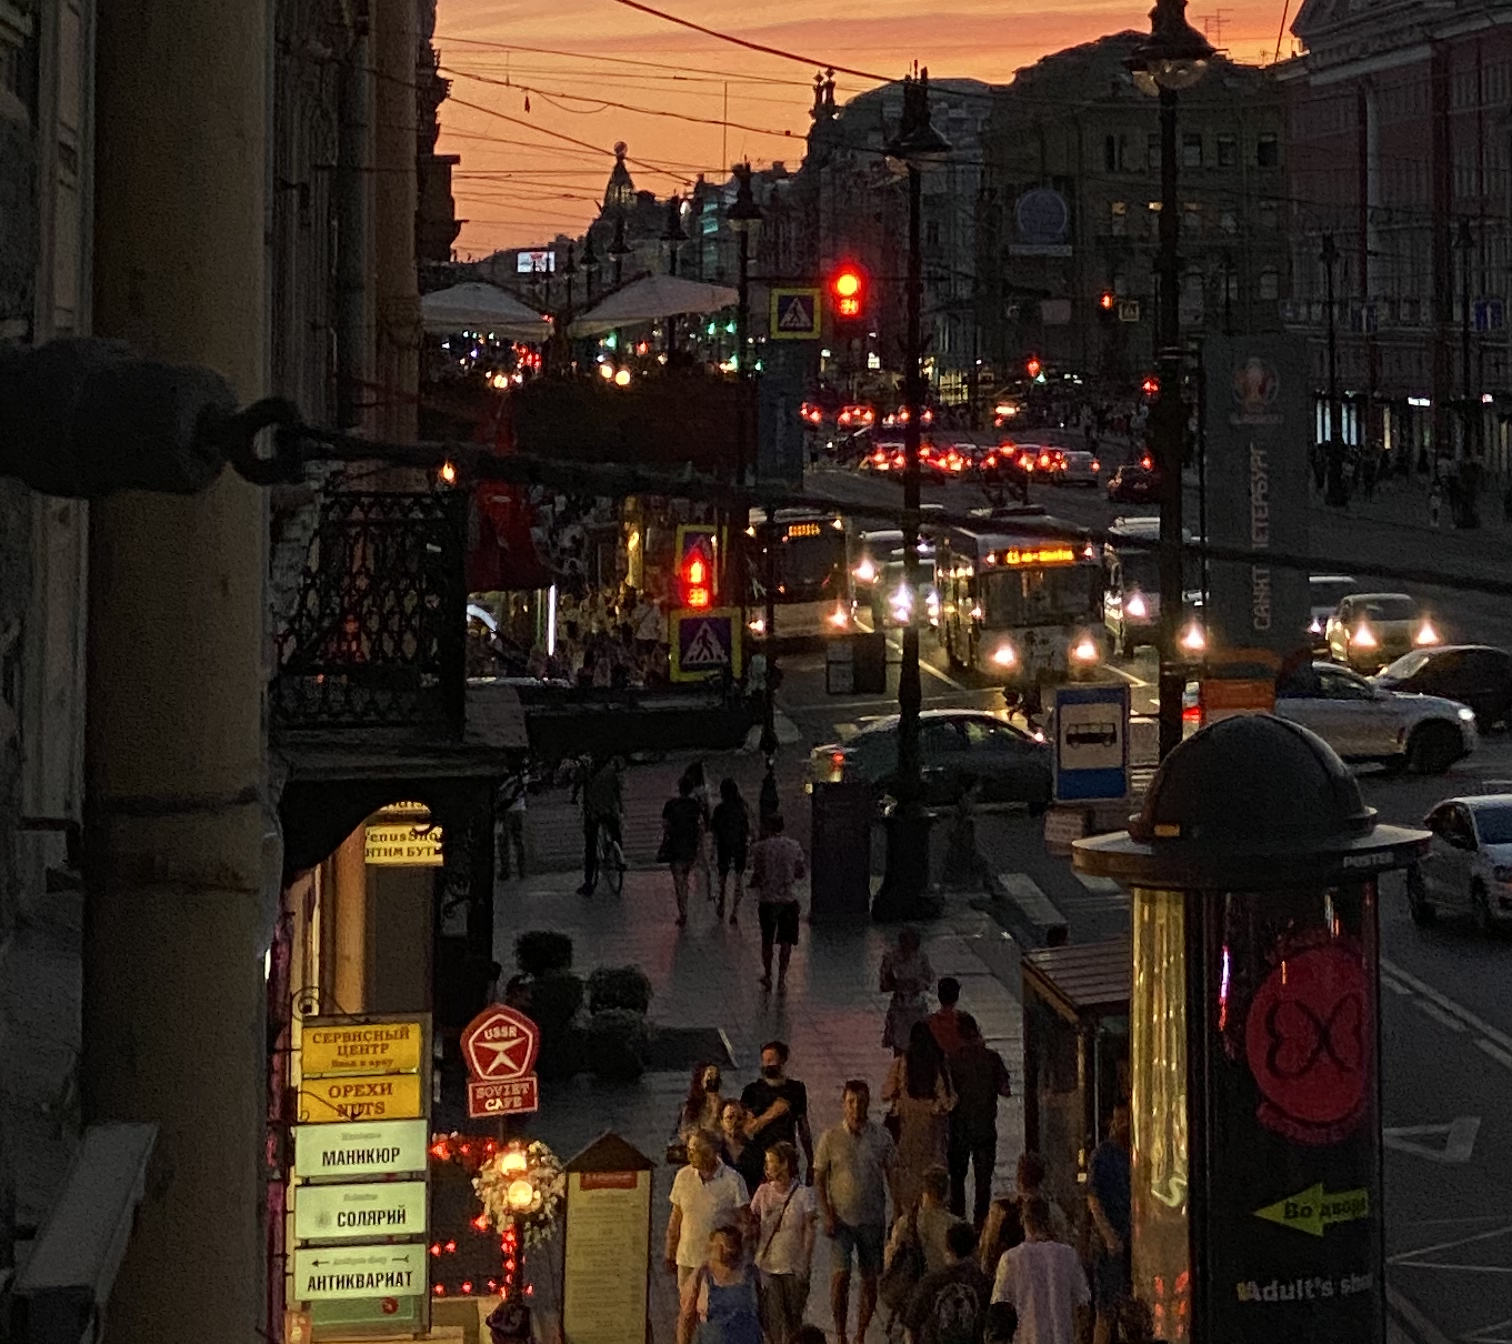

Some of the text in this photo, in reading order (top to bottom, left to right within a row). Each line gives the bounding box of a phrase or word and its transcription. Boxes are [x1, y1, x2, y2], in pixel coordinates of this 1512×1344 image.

[312, 1026, 410, 1044] СЕРВИСНЫЙ
[337, 1043, 390, 1057] ЦЕНТР
[328, 1082, 393, 1099] ОРЕХИ
[337, 1101, 385, 1117] NUTS
[322, 1147, 401, 1167] МАНИКЮР
[337, 1204, 406, 1227] СОЛЯРИЙ
[307, 1271, 414, 1292] АНТИКВАРИАТ
